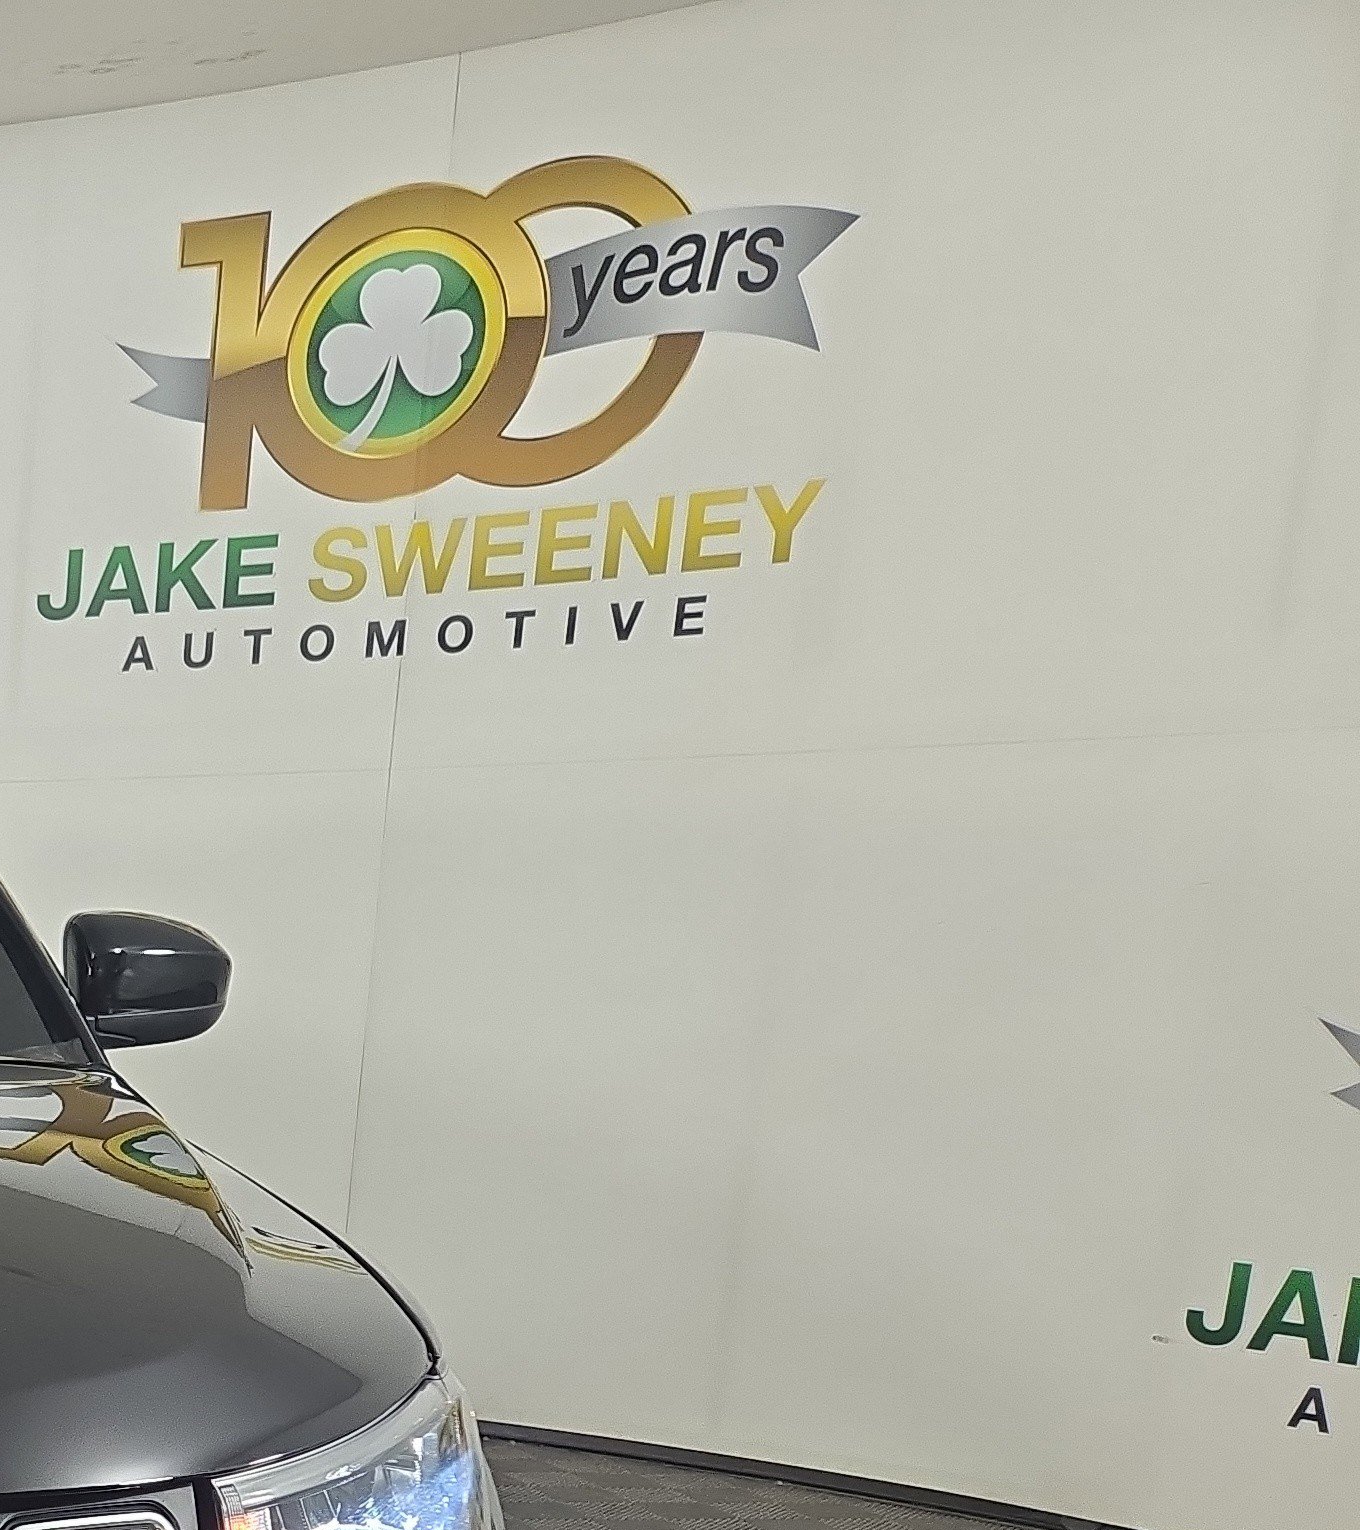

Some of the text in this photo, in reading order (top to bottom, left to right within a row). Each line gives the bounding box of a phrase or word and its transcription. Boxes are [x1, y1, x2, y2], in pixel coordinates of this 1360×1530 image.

[562, 222, 784, 339] years
[37, 478, 828, 621] JAKE SWEENEY
[121, 594, 709, 673] AUTOMOTIVE
[1185, 1261, 1360, 1366] JA
